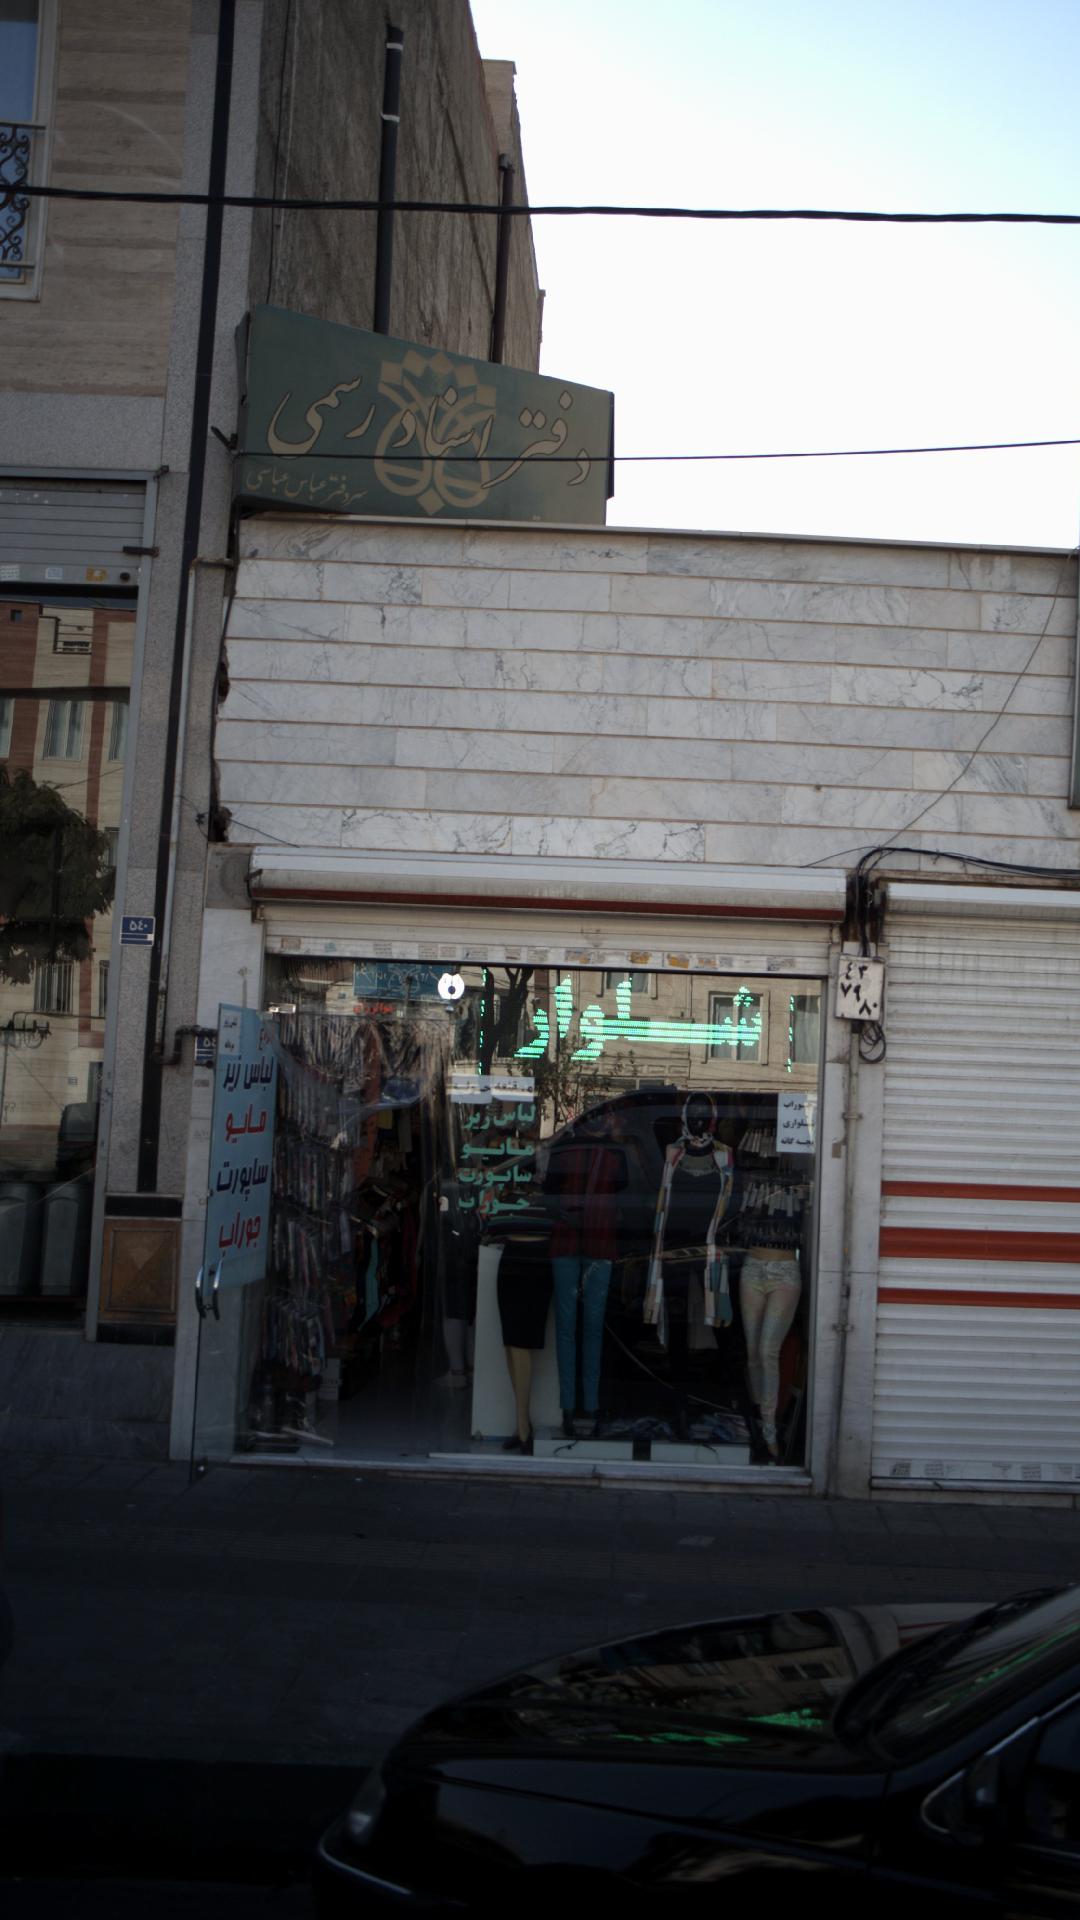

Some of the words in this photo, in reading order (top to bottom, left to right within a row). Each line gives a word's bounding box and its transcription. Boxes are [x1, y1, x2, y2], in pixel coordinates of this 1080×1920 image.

[267, 376, 376, 460] رسمی
[392, 386, 494, 460] اسناد
[481, 389, 591, 490] دفتر
[222, 1054, 242, 1093] زیر
[244, 1055, 275, 1092] لباس
[225, 1103, 268, 1144] مایو
[463, 1105, 491, 1131] زیر
[493, 1102, 537, 1127] لباس
[460, 1136, 534, 1161] مایو
[216, 1158, 269, 1201] ساپورت
[457, 1164, 533, 1191] ساپورت
[458, 1189, 531, 1216] جوراب
[219, 1211, 261, 1257] جوراب
